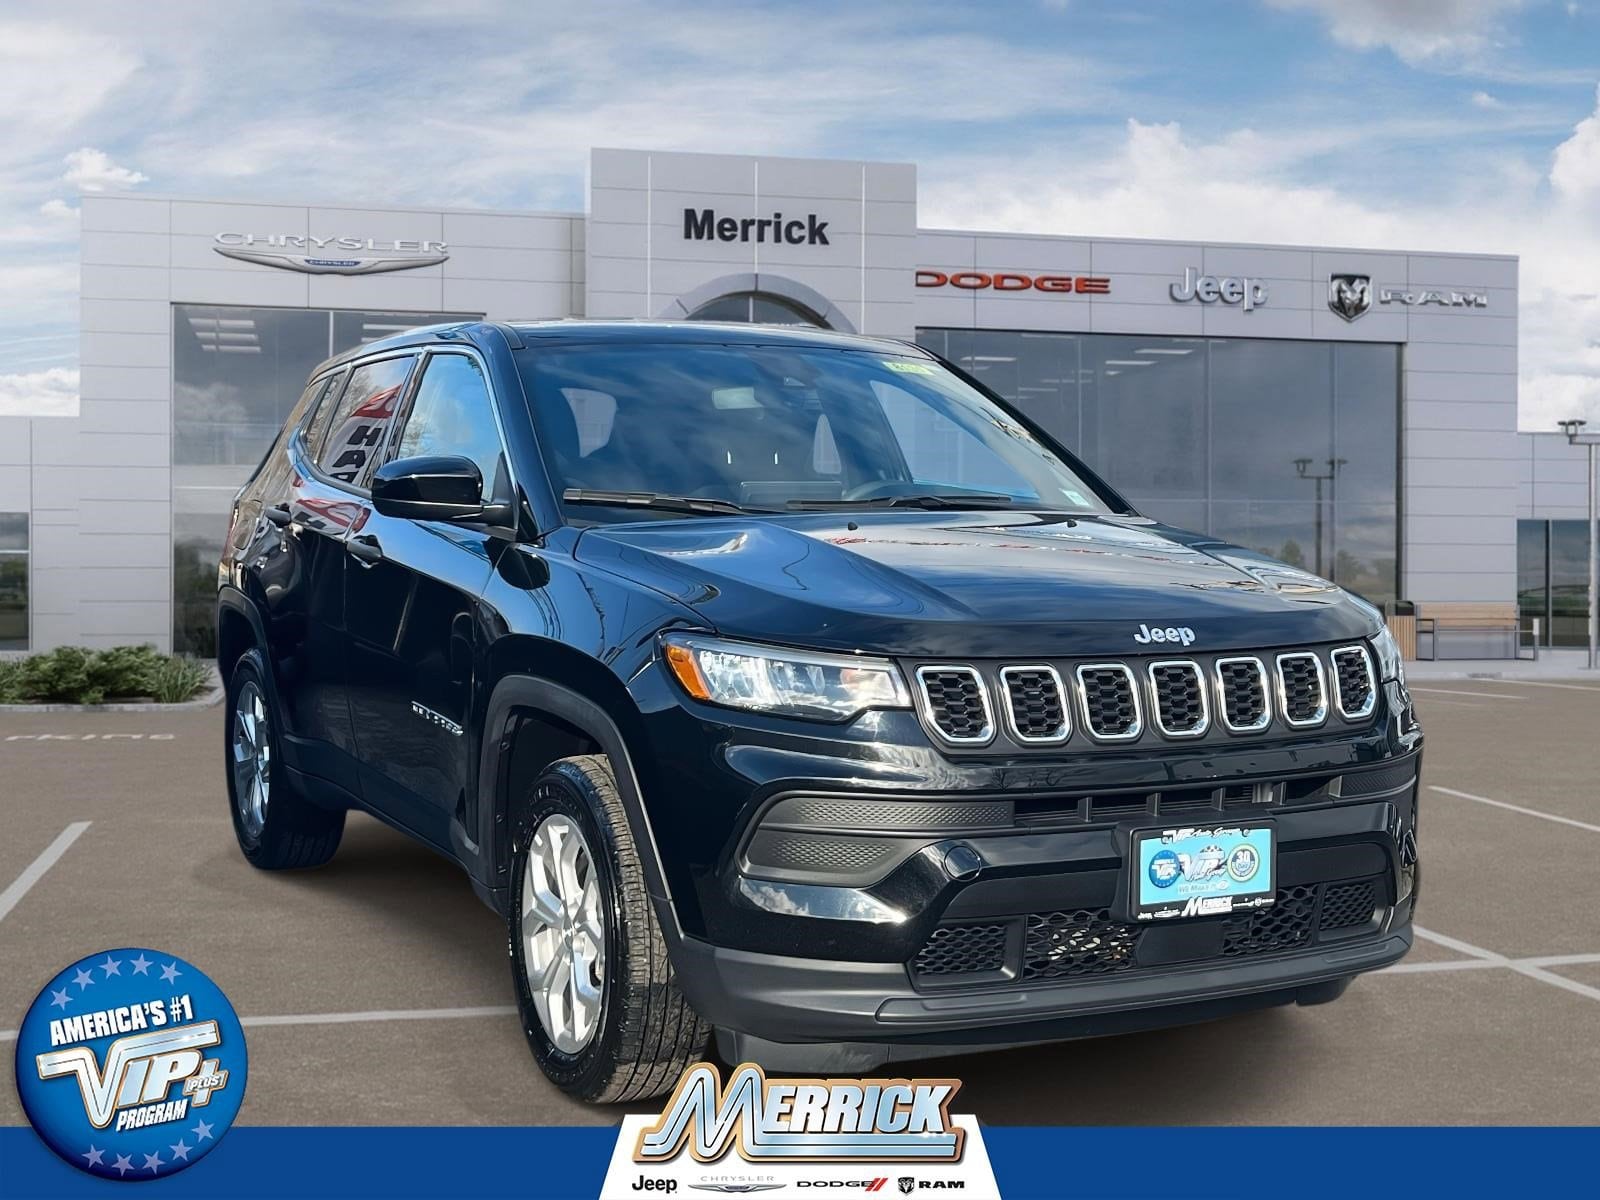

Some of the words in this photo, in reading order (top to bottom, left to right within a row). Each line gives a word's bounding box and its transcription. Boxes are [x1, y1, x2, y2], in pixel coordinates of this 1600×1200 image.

[683, 208, 830, 246] Merrick
[214, 232, 449, 254] CHRYSLER
[915, 271, 1111, 294] DODGE
[1169, 267, 1268, 311] Jeep
[1379, 288, 1488, 308] RAM
[1133, 623, 1196, 647] Jeep
[1236, 850, 1250, 863] 30
